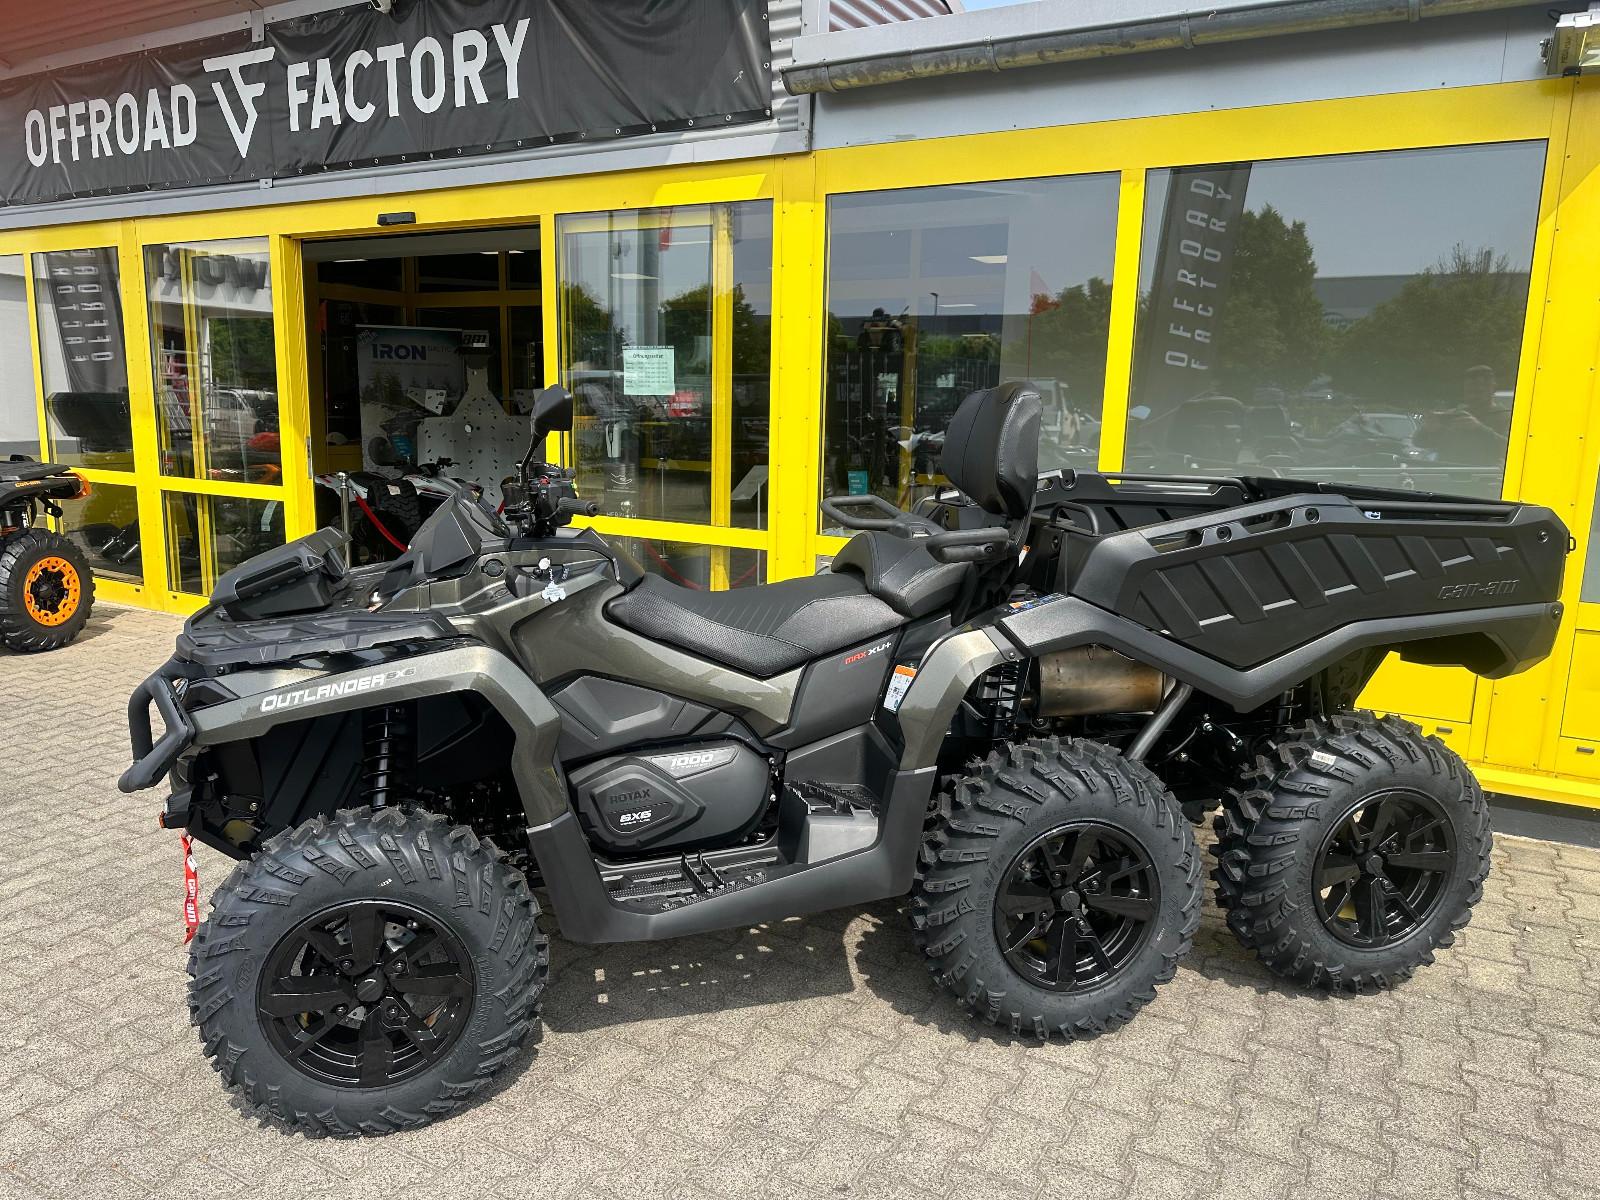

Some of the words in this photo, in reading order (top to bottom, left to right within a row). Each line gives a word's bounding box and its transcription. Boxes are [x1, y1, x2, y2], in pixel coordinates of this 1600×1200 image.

[287, 17, 531, 132] FACTORY
[25, 83, 197, 167] OFFROAD
[1165, 178, 1215, 368] OFFROAD
[1190, 186, 1233, 371] FACTORY
[371, 343, 427, 360] IRON
[1437, 579, 1520, 600] can-am
[844, 650, 867, 665] MAX
[867, 641, 892, 656] XU+
[260, 673, 385, 713] OUTLANDER
[671, 753, 714, 768] 1000
[610, 788, 651, 804] ROTAX
[619, 809, 652, 823] 6X6
